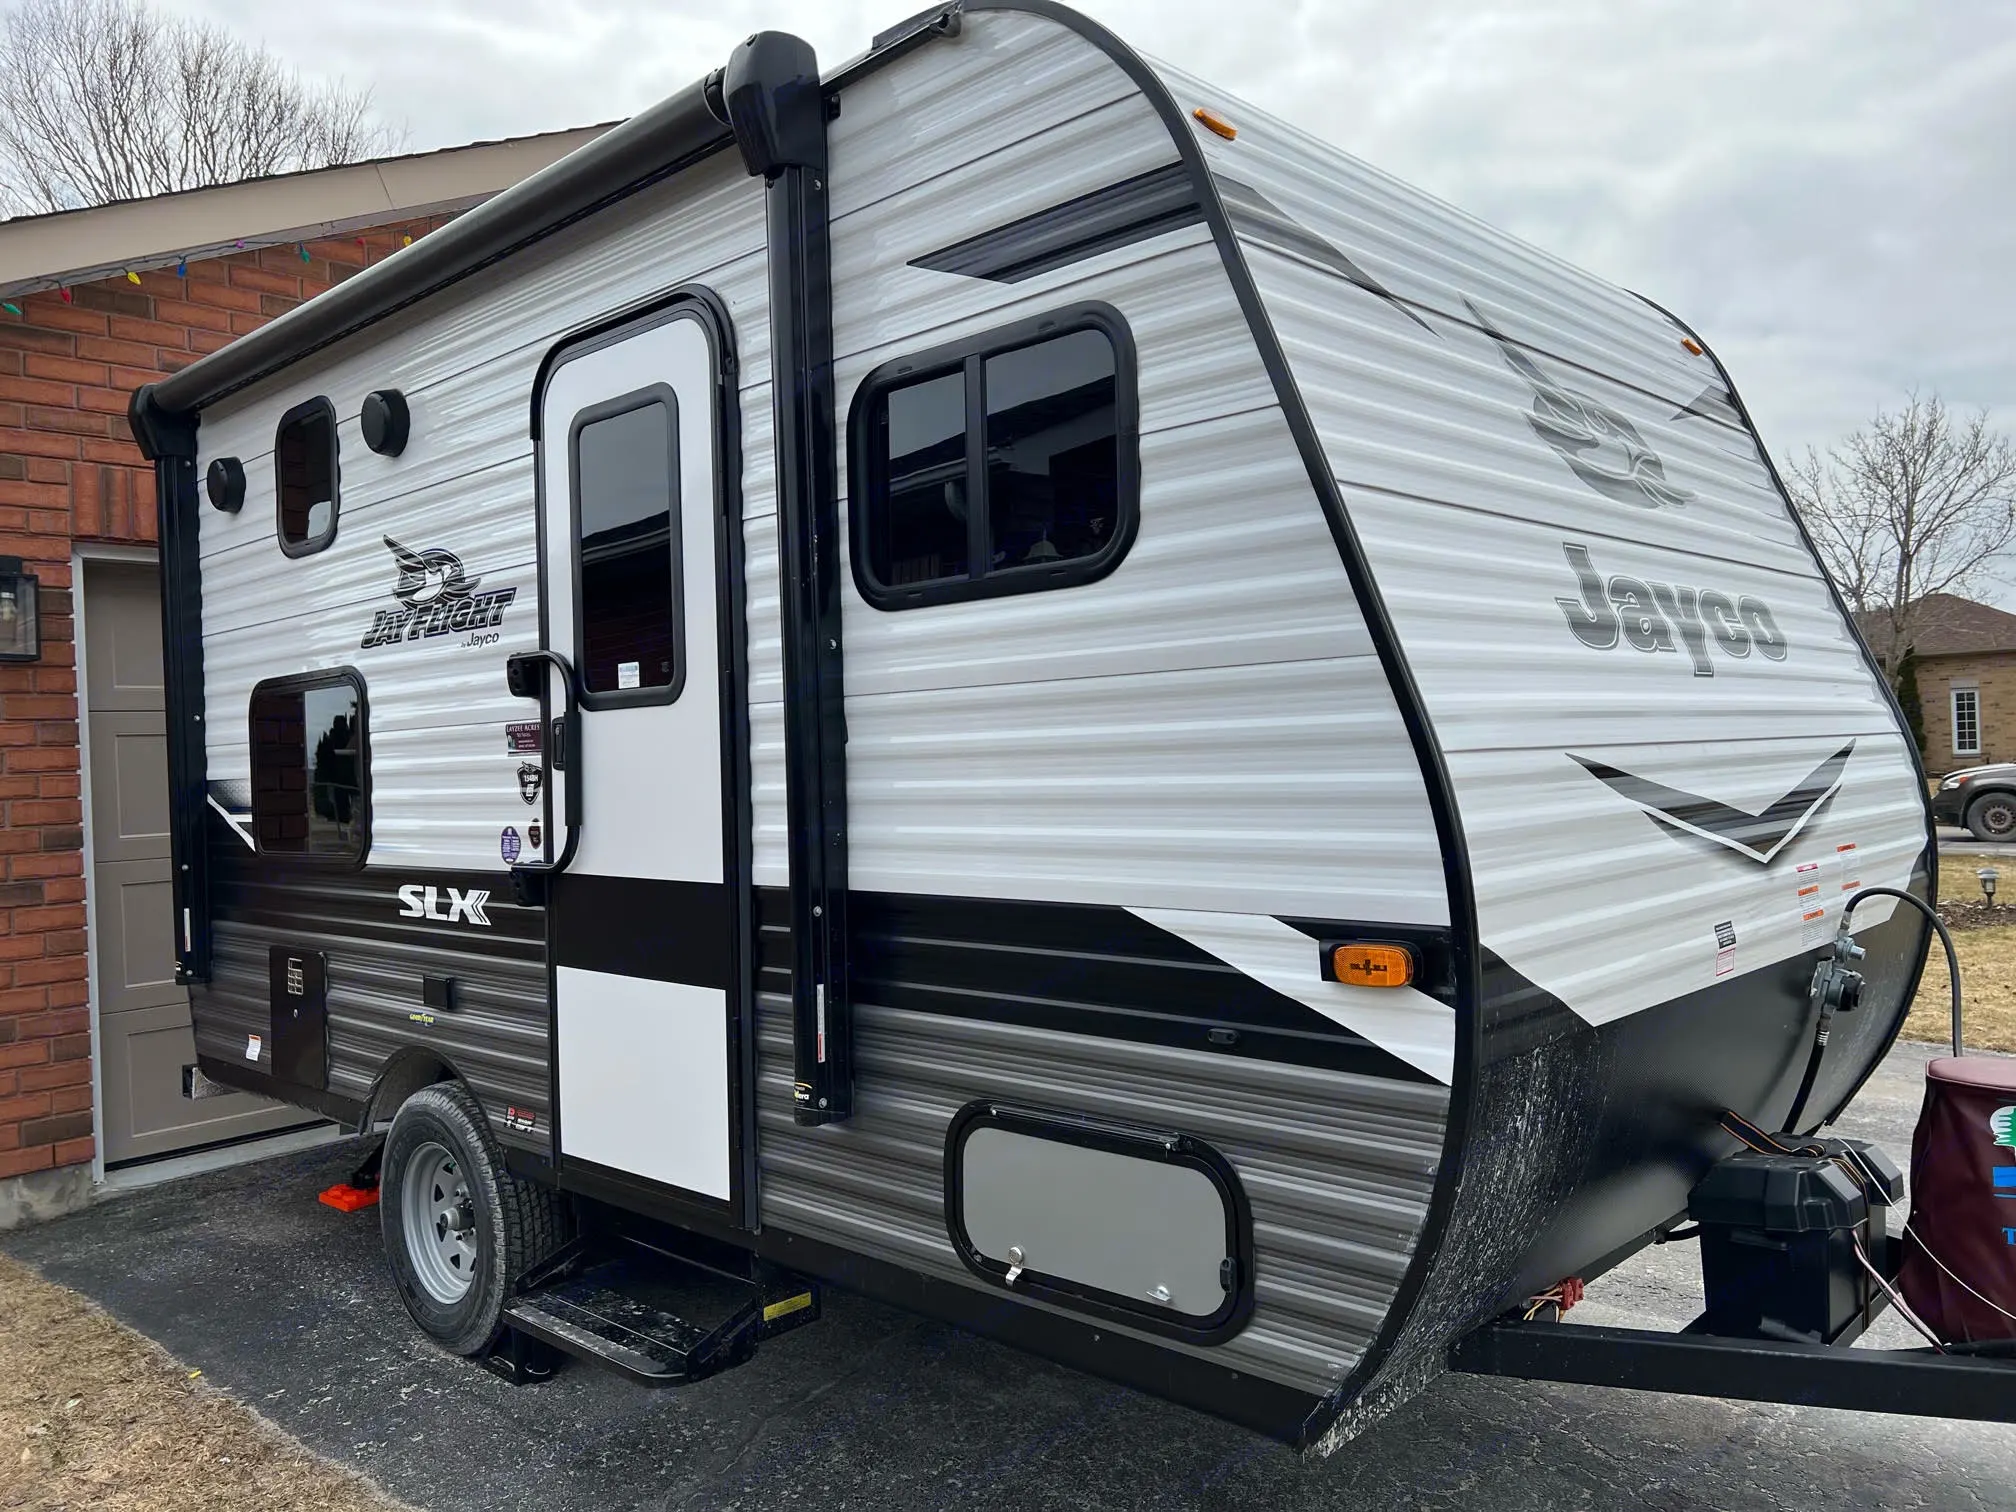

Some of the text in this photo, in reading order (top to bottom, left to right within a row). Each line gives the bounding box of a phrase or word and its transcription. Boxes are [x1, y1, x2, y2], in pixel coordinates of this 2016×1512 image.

[1554, 542, 1788, 678] Jayco
[466, 633, 500, 648] Jayco
[398, 884, 492, 926] SLX
